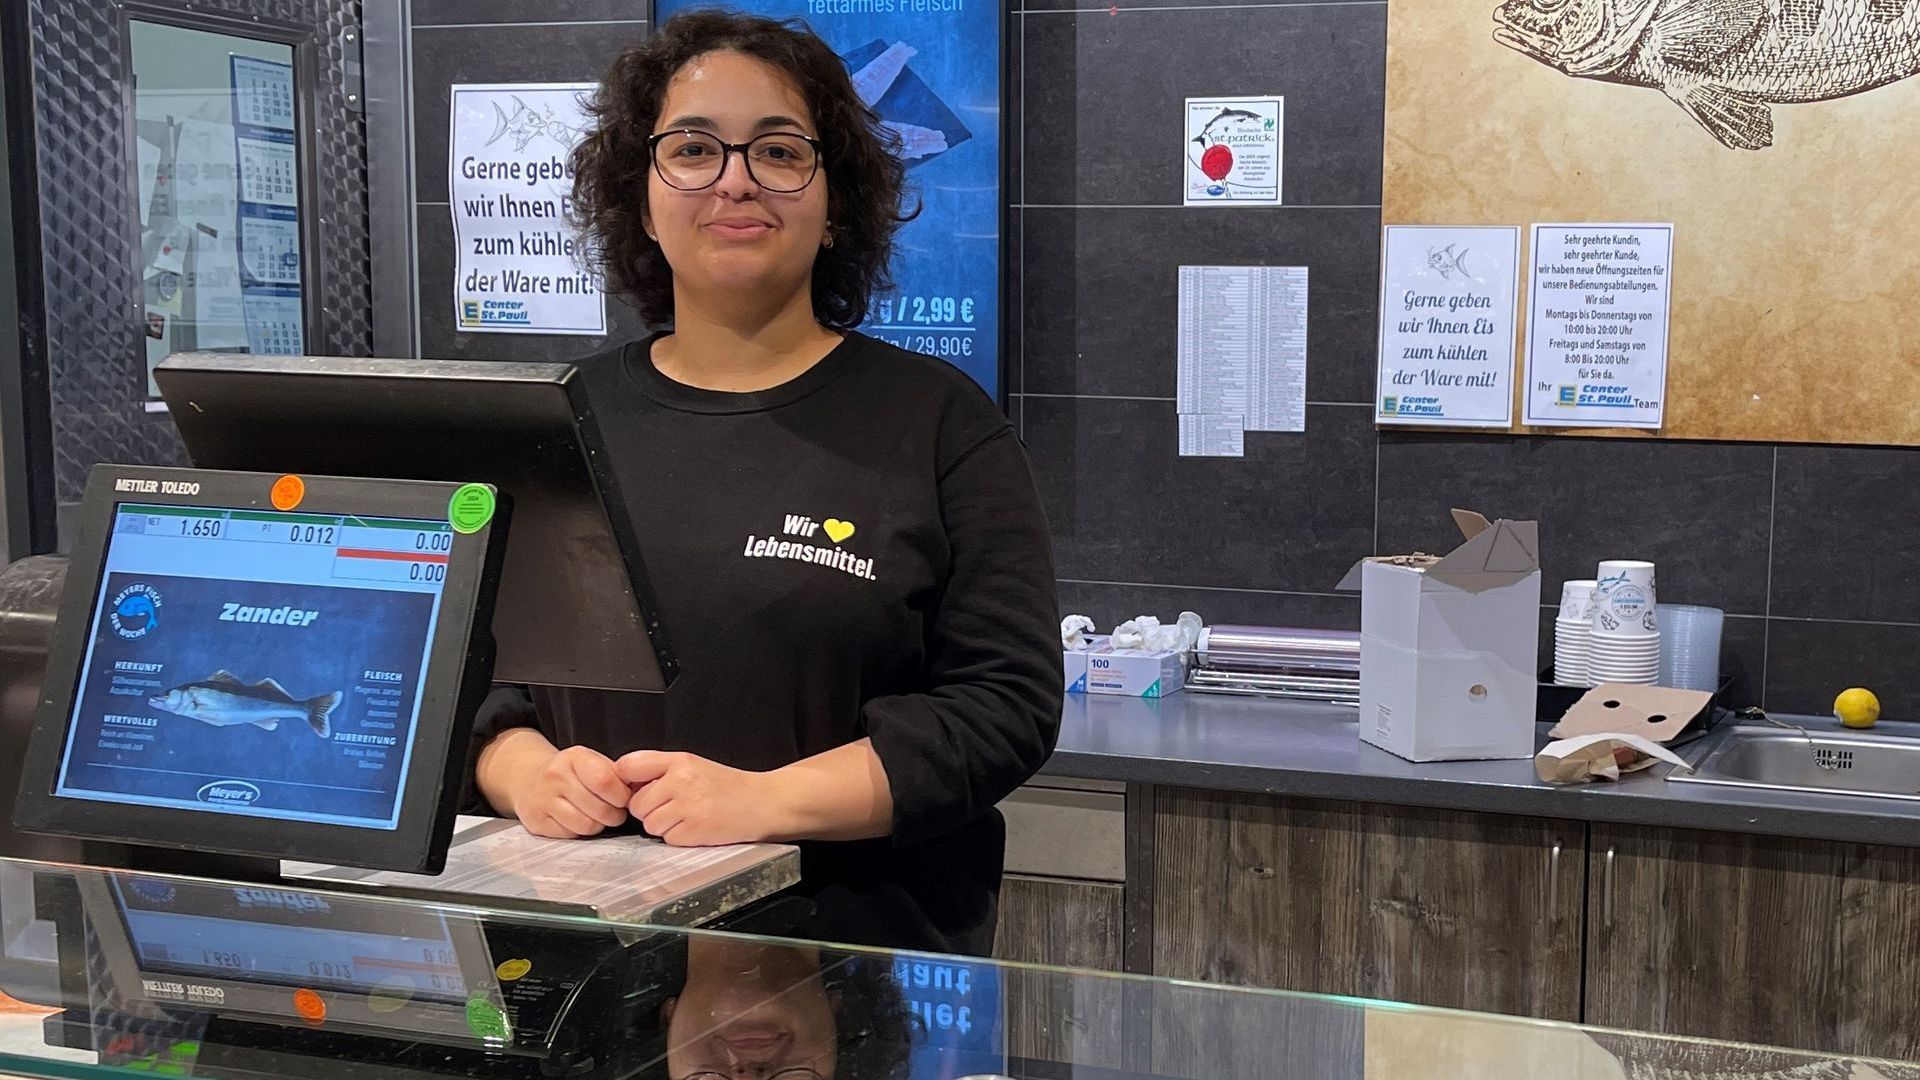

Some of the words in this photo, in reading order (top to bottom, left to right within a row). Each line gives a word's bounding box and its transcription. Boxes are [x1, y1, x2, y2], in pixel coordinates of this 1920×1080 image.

[462, 156, 521, 180] Gerne
[463, 193, 494, 217] wir
[500, 193, 556, 218] Ihnen
[473, 238, 514, 255] zum
[1564, 234, 1581, 245] Sehr
[1582, 234, 1611, 247] geehrte
[1612, 234, 1641, 246] Kundin,
[1564, 250, 1580, 260] sehr
[1581, 250, 1613, 262] geehrter
[1614, 250, 1640, 261] Kunde,
[1538, 264, 1551, 274] wir
[1551, 264, 1574, 275] haben
[1595, 263, 1652, 277] Öffnungszeiten
[1653, 265, 1664, 276] für
[465, 268, 498, 292] der
[502, 269, 551, 293] Ware
[556, 270, 594, 294] mit!
[1542, 281, 1568, 290] unsere
[1569, 280, 1658, 293] Bedienungsabteilungen.
[484, 300, 524, 309] Center
[1404, 290, 1445, 311] Gerne
[1448, 292, 1492, 312] geben
[1585, 295, 1597, 305] Wir
[1598, 295, 1614, 305] sind
[898, 296, 907, 321] /
[912, 297, 955, 325] 2,99
[960, 297, 974, 323] €
[1545, 309, 1578, 322] Montags
[1579, 309, 1589, 320] bis
[1591, 310, 1637, 323] Donnerstags
[1398, 317, 1423, 333] wir
[1427, 317, 1470, 334] Ihnen
[1473, 317, 1494, 334] Eis
[1564, 324, 1584, 334] 10:00
[1585, 324, 1596, 334] bis
[1597, 325, 1618, 335] 20:00
[1619, 325, 1633, 335] Uhr
[1549, 338, 1578, 351] Freitags
[1580, 339, 1595, 349] und
[1596, 339, 1630, 352] Samstags
[1631, 343, 1646, 351] von
[1402, 347, 1433, 359] zum
[1437, 344, 1488, 361] kühlen
[1564, 354, 1581, 364] 8:00
[1581, 354, 1593, 364] Bis
[1594, 355, 1615, 364] 20:00
[1616, 355, 1629, 365] Uhr
[1392, 369, 1417, 385] der
[1420, 368, 1463, 386] Ware
[1465, 371, 1497, 387] mit!
[1578, 368, 1589, 379] für
[1590, 369, 1601, 379] Sie
[1603, 369, 1614, 379] da.
[1538, 381, 1552, 391] Ihr
[1583, 384, 1628, 394] Center
[1402, 396, 1439, 404] Center
[1634, 398, 1658, 408] Team
[115, 479, 158, 493] METTLER
[161, 481, 200, 495] TOLEDO
[181, 519, 221, 537] 1.650
[783, 514, 819, 537] Wir
[290, 525, 334, 544] 0.012
[416, 532, 451, 551] 0.00
[743, 535, 877, 581] Lebensmittel.
[410, 563, 445, 581] 0.00
[113, 584, 145, 607] MEYERS
[145, 586, 162, 608] FISCH
[218, 602, 319, 626] Zander
[114, 661, 163, 673] HERKUNFT
[1091, 659, 1109, 669] 100
[364, 670, 402, 681] FLEISCH
[104, 715, 158, 727] WERTVOLLES
[334, 732, 396, 745] ZUBEREITUNG
